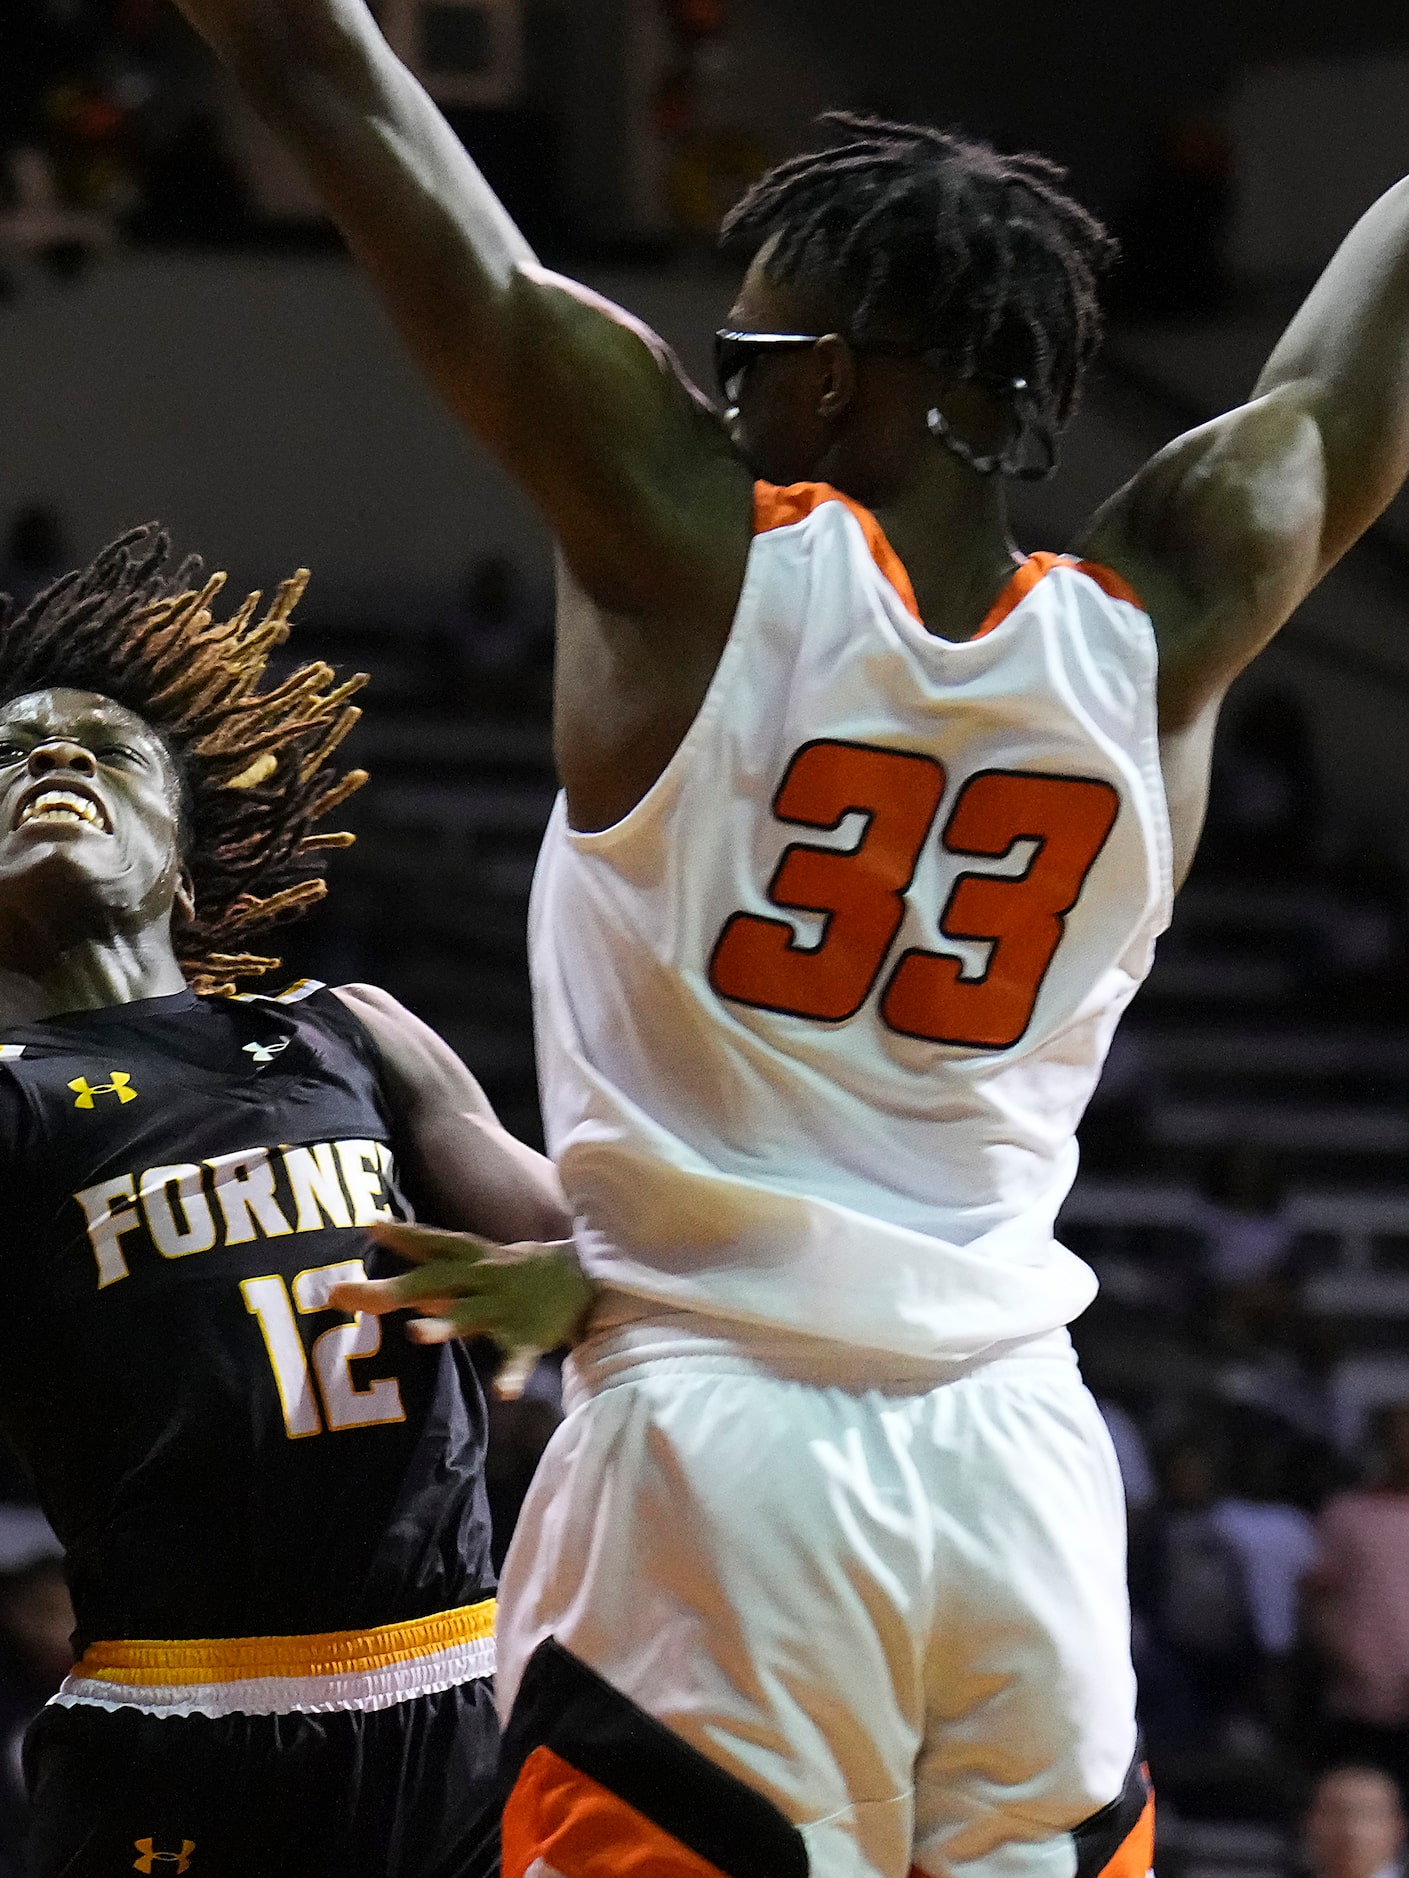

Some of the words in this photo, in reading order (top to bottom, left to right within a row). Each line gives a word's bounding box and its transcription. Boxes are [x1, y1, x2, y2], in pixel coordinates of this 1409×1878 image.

[708, 738, 1120, 1049] 33
[74, 1139, 394, 1289] FORNE
[239, 1259, 407, 1439] 12
